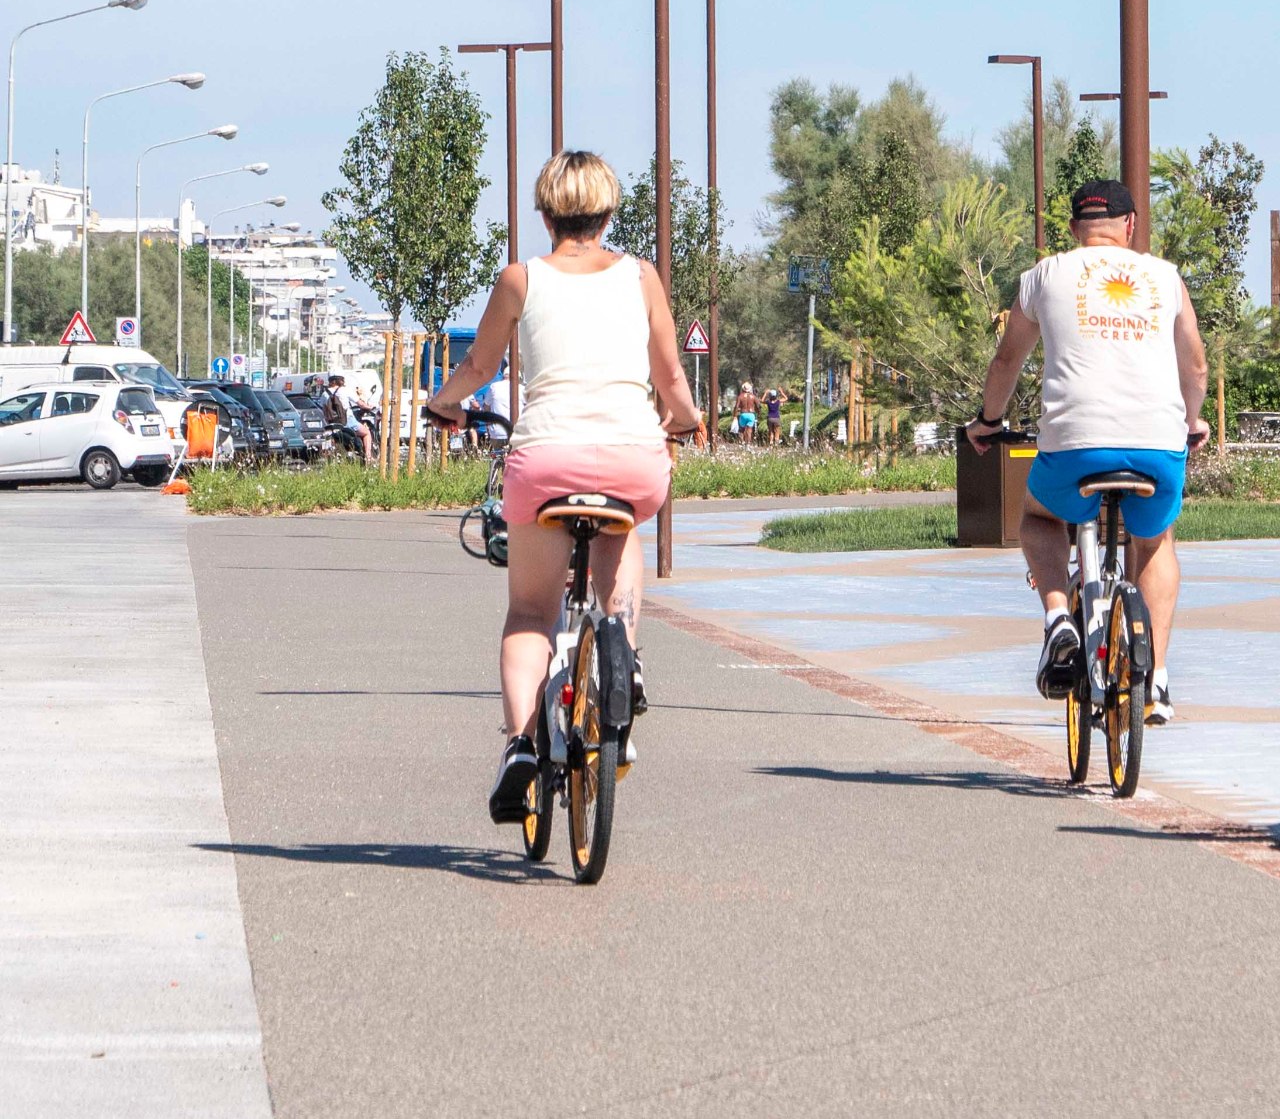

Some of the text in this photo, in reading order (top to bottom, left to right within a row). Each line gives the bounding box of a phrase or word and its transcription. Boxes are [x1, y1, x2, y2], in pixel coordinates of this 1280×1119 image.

[1077, 294, 1089, 327] HERE
[1088, 315, 1150, 332] ORIGINAL
[1100, 329, 1144, 341] CREW
